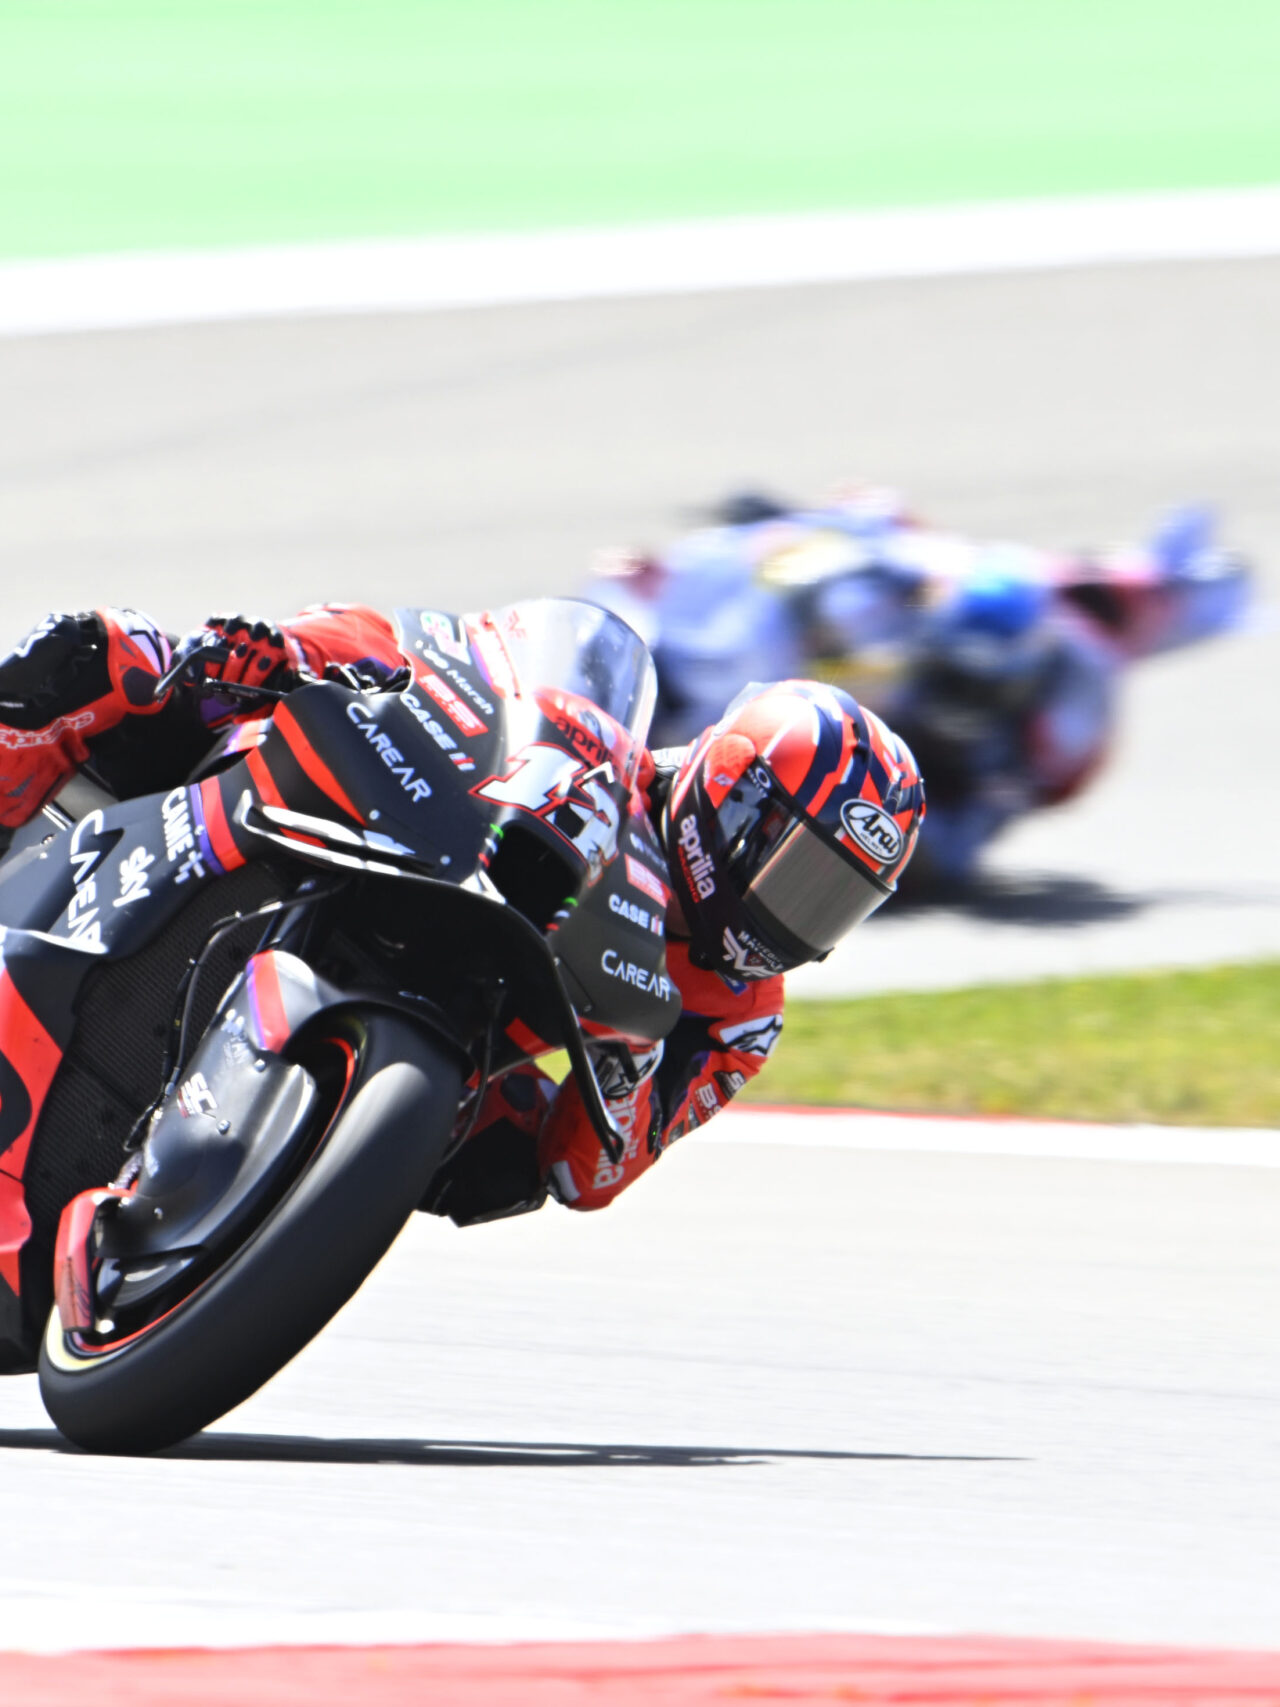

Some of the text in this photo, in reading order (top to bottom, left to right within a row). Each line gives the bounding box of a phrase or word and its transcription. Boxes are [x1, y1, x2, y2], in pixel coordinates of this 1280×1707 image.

[400, 692, 458, 751] CASE
[346, 702, 433, 803] CAREAR
[678, 813, 716, 900] aprilia
[849, 804, 899, 854] Arai
[608, 894, 648, 926] CASE
[601, 949, 671, 1002] CAREAR
